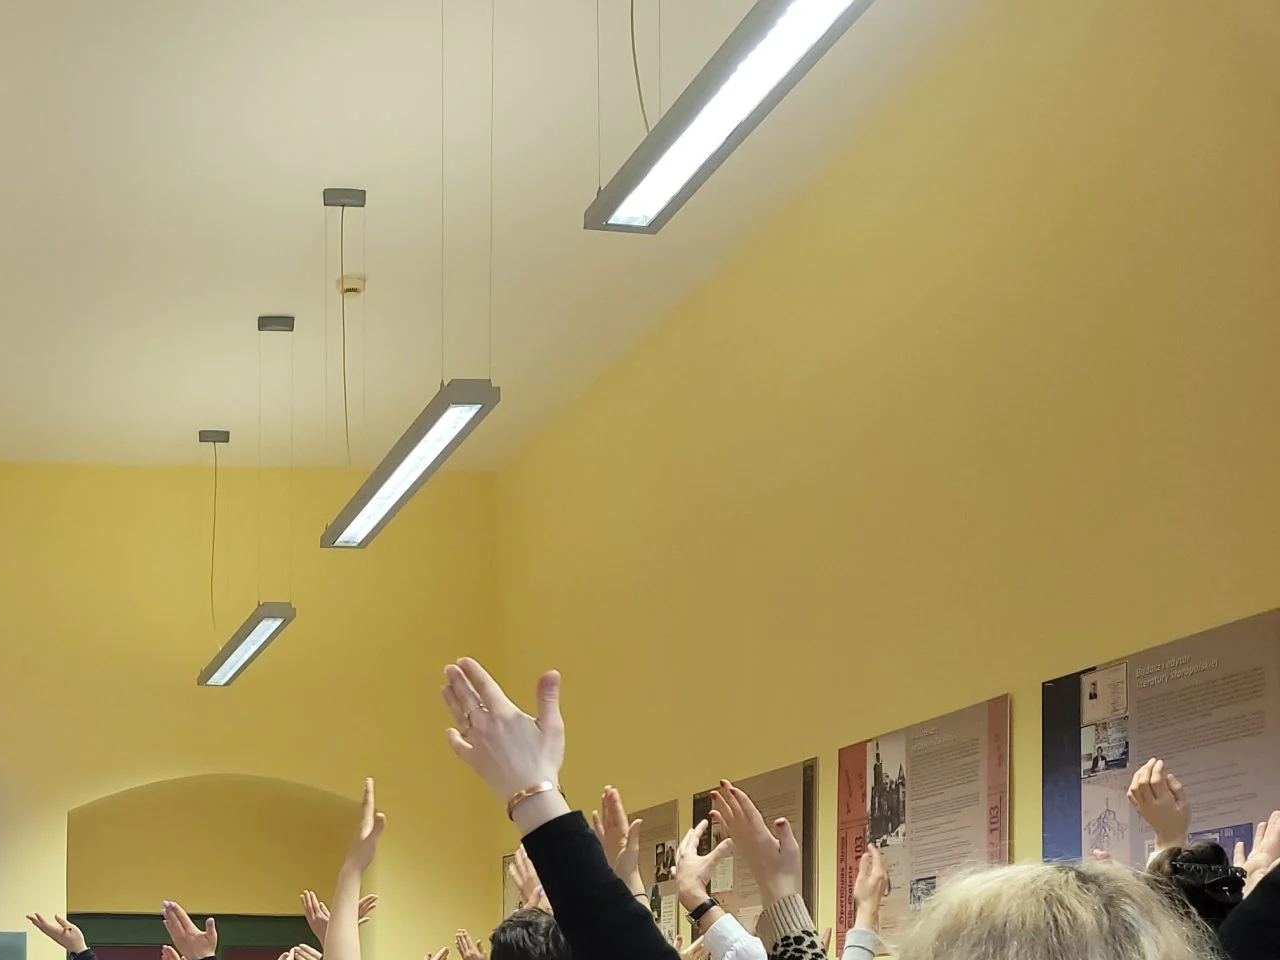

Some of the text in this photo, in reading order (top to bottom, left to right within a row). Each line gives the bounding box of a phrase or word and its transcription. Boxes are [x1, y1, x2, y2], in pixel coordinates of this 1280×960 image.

[1136, 663, 1161, 678] Badacz
[1136, 658, 1219, 689] literatury staropolskiej
[990, 805, 999, 834] 103
[855, 835, 863, 861] 103
